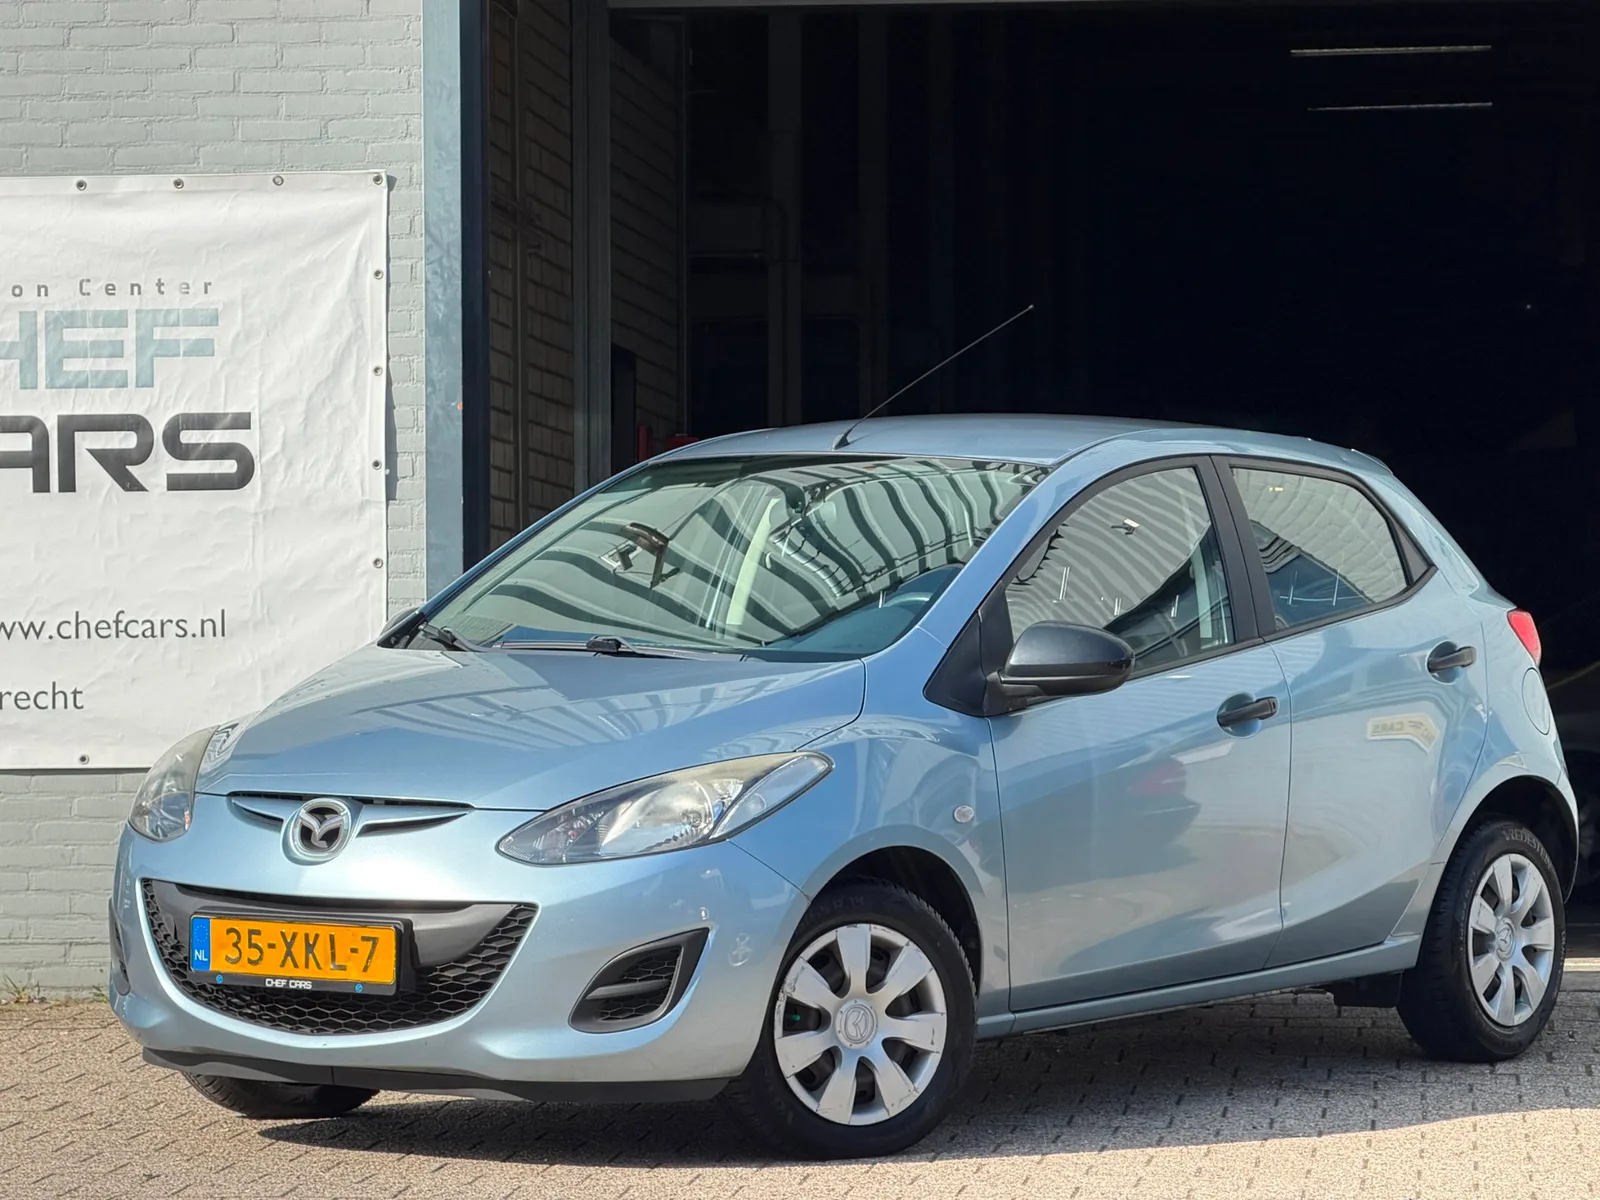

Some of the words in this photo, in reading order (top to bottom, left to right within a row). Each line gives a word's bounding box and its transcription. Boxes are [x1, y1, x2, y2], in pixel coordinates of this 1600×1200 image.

[78, 277, 212, 297] Center
[0, 681, 84, 710] recht
[194, 951, 208, 961] NL
[224, 927, 380, 973] 35-XKL-7
[265, 978, 287, 987] CHEF
[289, 980, 312, 989] CARS
